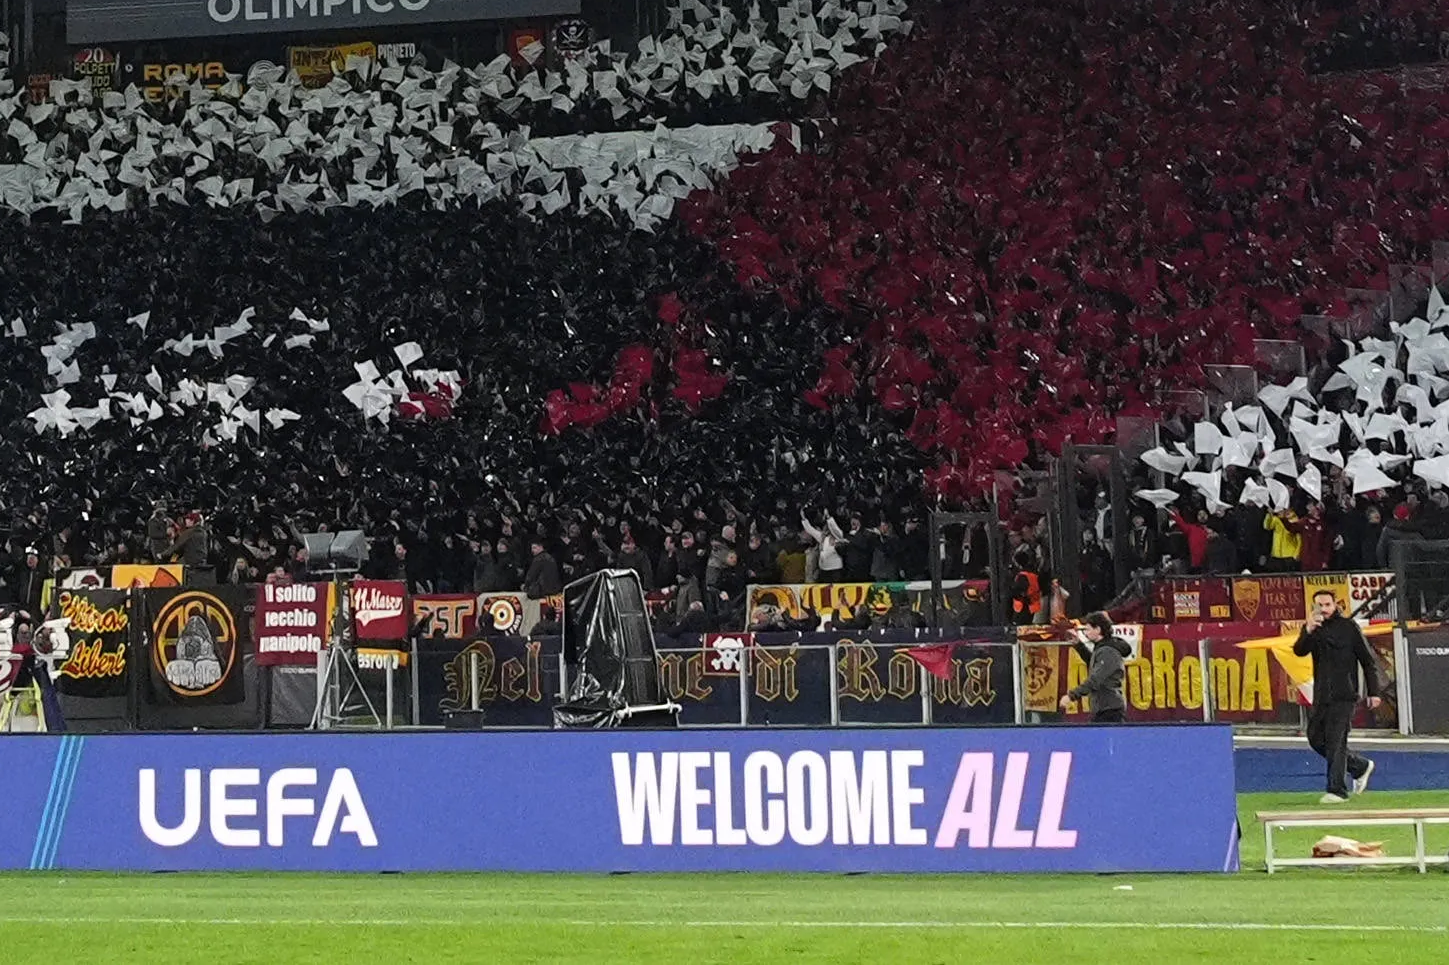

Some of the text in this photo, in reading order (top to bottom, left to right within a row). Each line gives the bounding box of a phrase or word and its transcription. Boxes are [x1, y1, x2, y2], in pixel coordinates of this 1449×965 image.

[144, 60, 224, 82] ROMA
[275, 584, 317, 603] solito
[1351, 576, 1386, 588] GABB
[1265, 592, 1287, 606] TEAR
[60, 637, 127, 679] Liberi
[439, 639, 543, 713] Nel
[755, 641, 799, 702] di
[139, 767, 379, 847] UEFA
[611, 750, 1078, 848] WELCOME ALL
